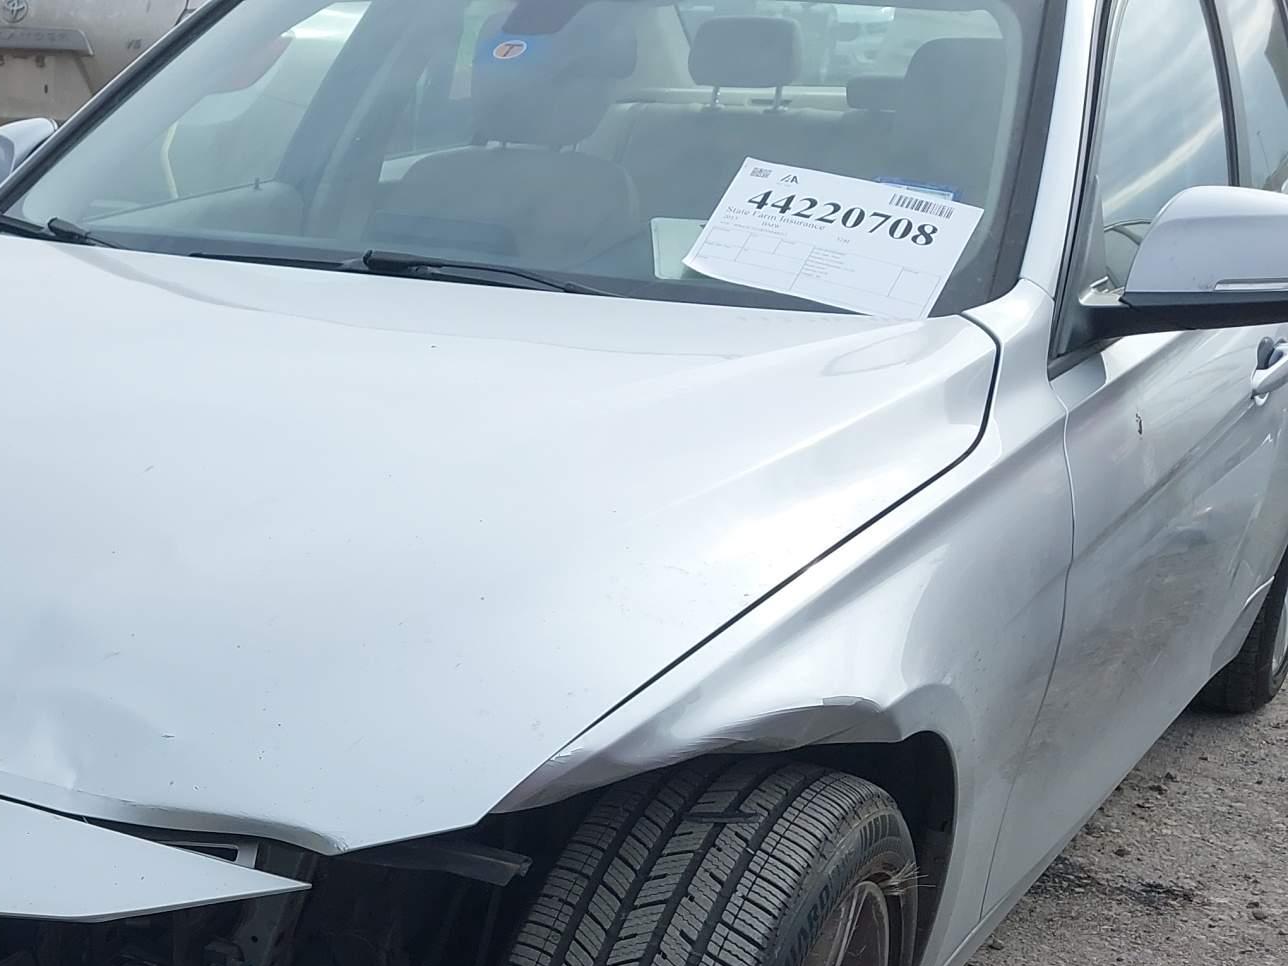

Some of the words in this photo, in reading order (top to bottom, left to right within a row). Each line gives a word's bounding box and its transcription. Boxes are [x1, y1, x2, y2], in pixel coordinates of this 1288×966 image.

[726, 206, 751, 216] State
[752, 210, 777, 221] Farm
[778, 215, 827, 232] Insurance
[747, 189, 939, 246] 44220708
